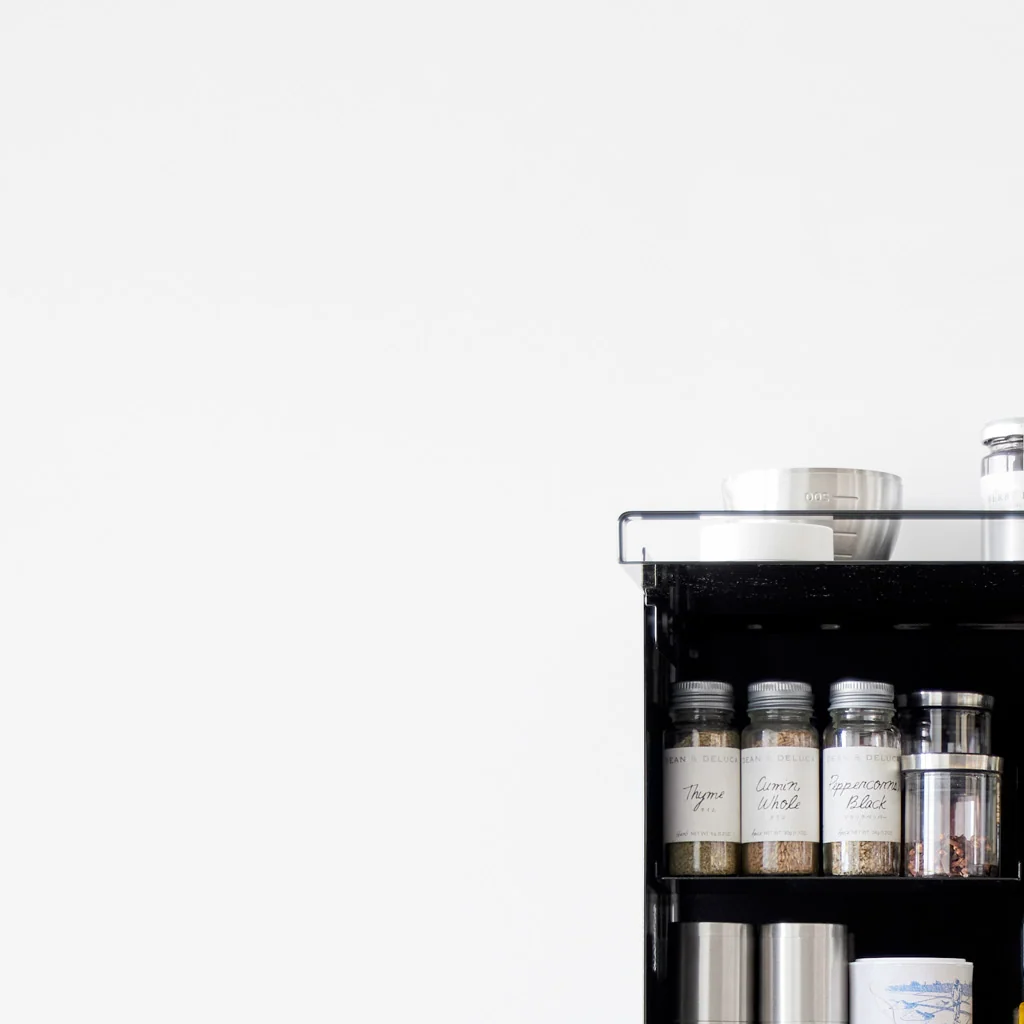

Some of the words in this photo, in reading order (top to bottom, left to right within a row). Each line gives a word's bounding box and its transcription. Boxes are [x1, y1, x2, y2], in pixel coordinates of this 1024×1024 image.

[683, 784, 725, 812] Thyme
[757, 795, 801, 811] Whole
[846, 794, 887, 810] Black
